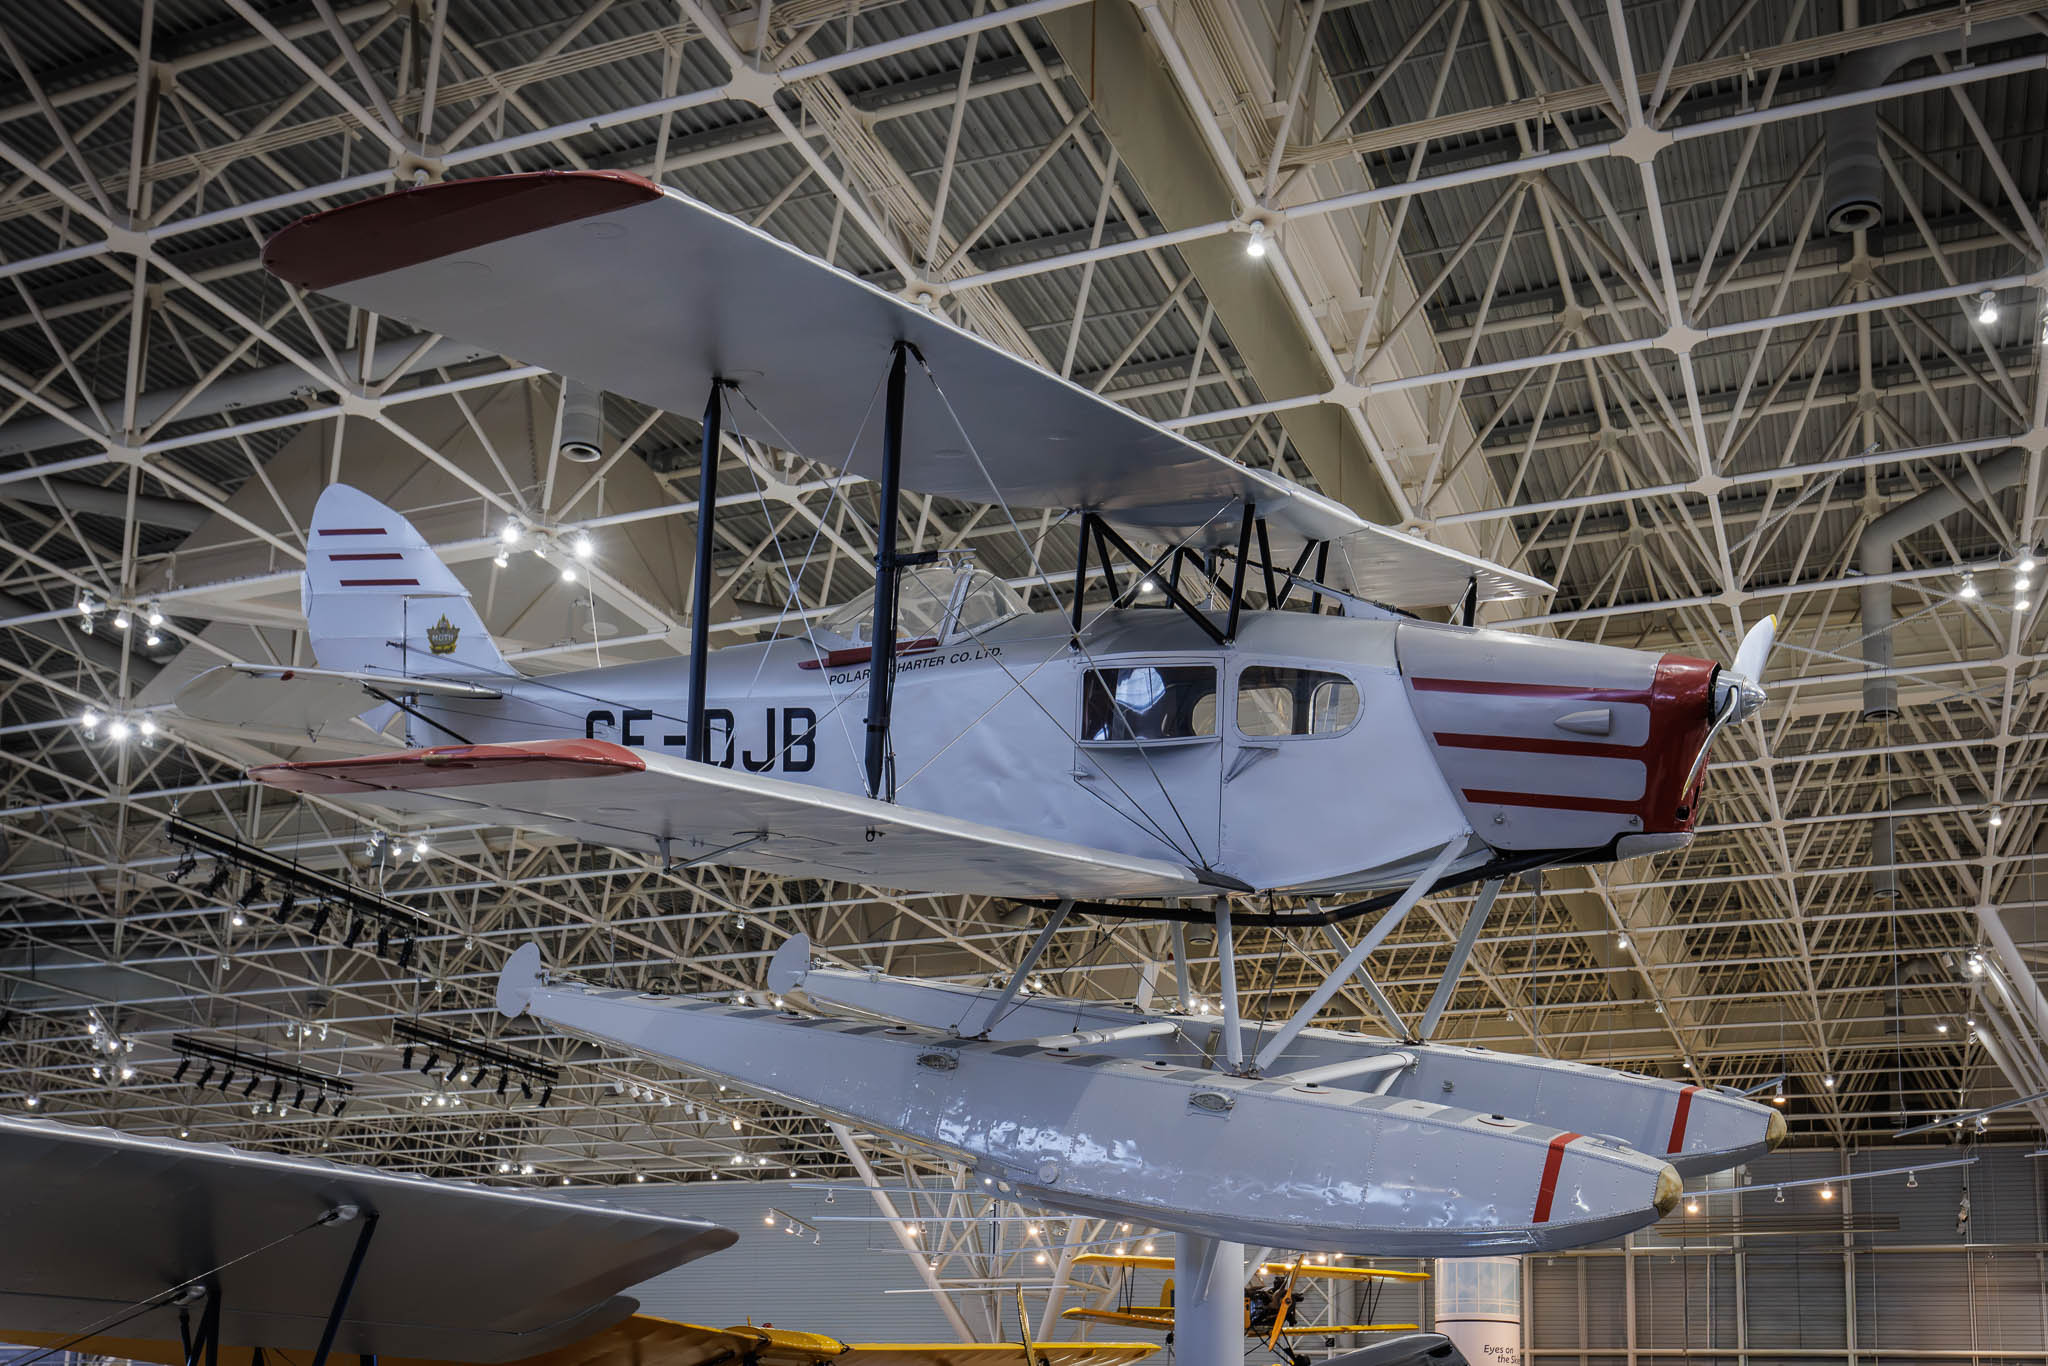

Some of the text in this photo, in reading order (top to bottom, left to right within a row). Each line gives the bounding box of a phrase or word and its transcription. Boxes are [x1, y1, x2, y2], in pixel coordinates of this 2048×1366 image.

[829, 670, 871, 685] POLAR
[892, 656, 945, 674] HARTER
[1484, 1344, 1504, 1356] Eyes
[1497, 1354, 1510, 1364] the
